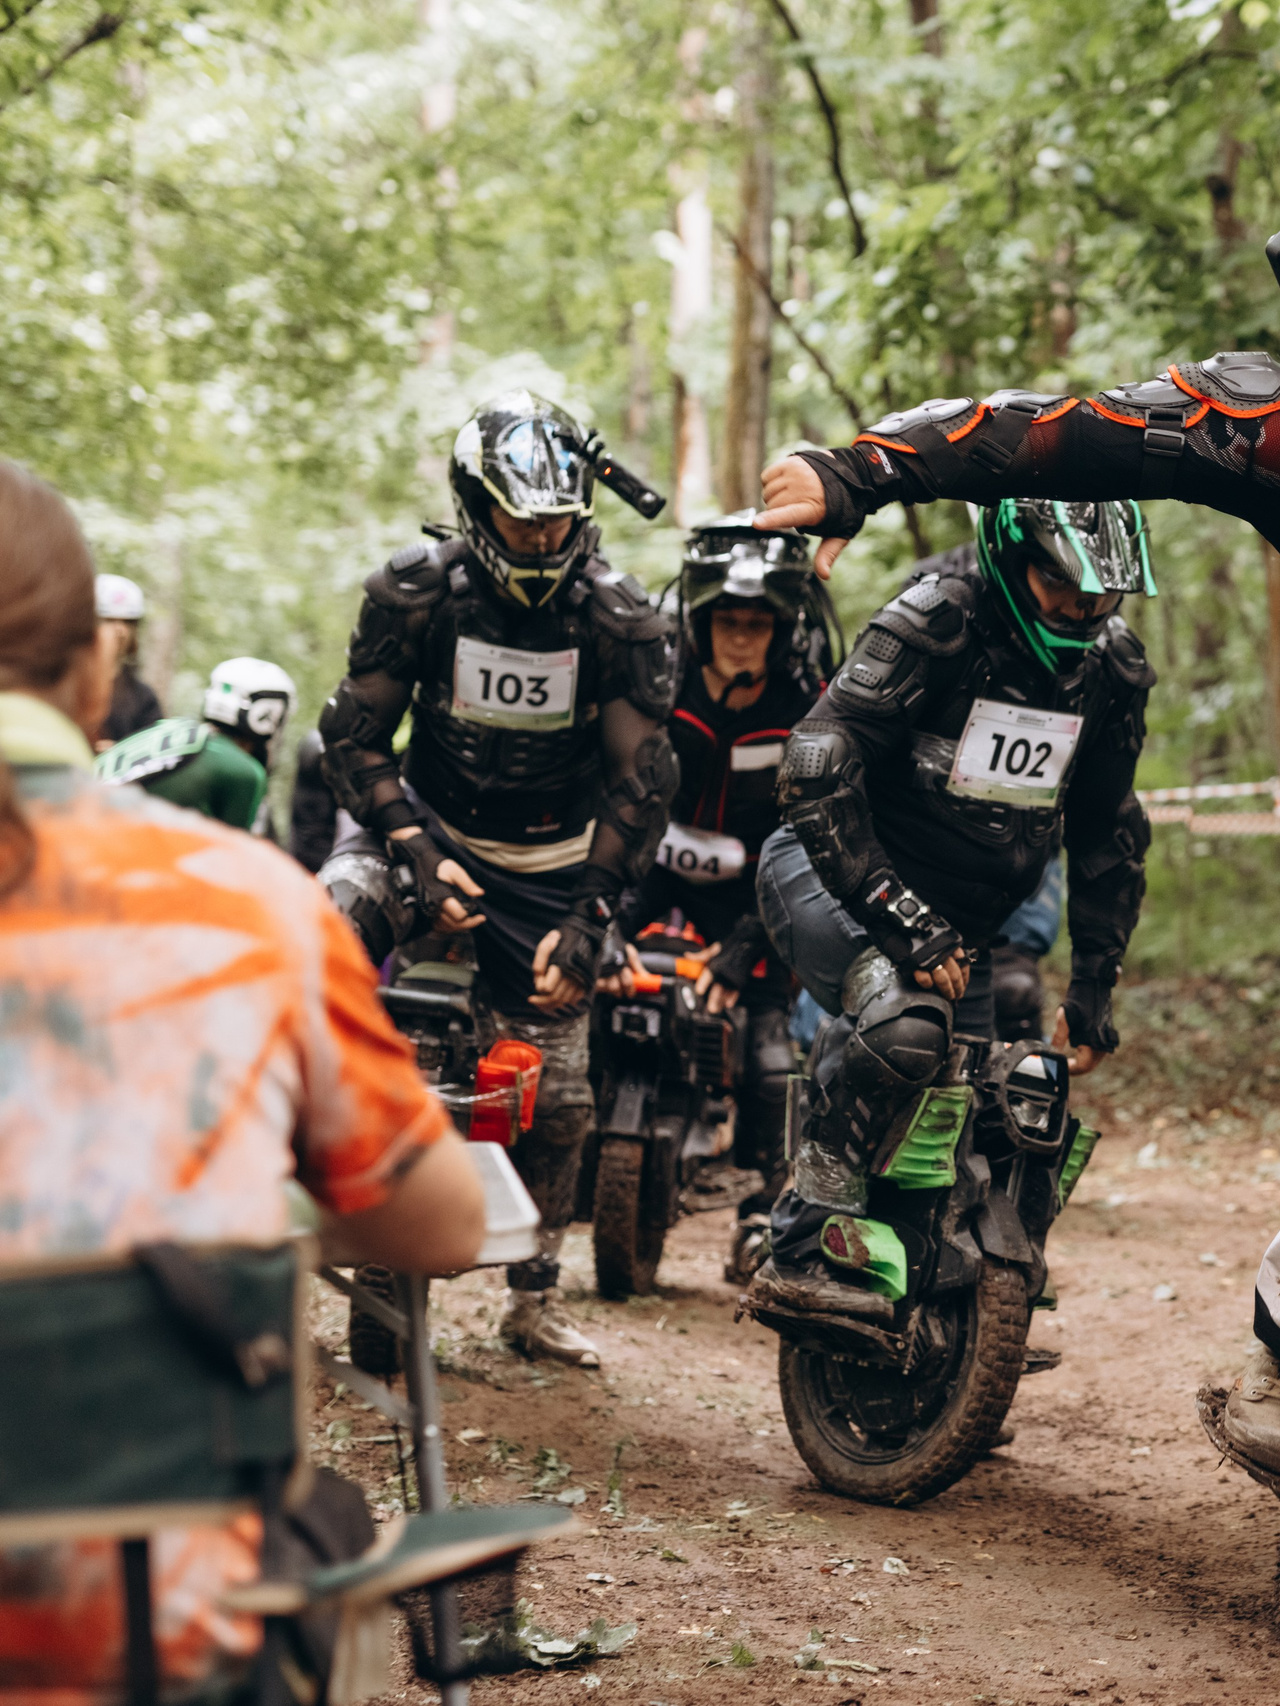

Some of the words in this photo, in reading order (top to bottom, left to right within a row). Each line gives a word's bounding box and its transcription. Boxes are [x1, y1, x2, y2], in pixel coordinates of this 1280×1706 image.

[479, 667, 551, 707] 103
[989, 732, 1052, 778] 102
[664, 844, 720, 875] 104
